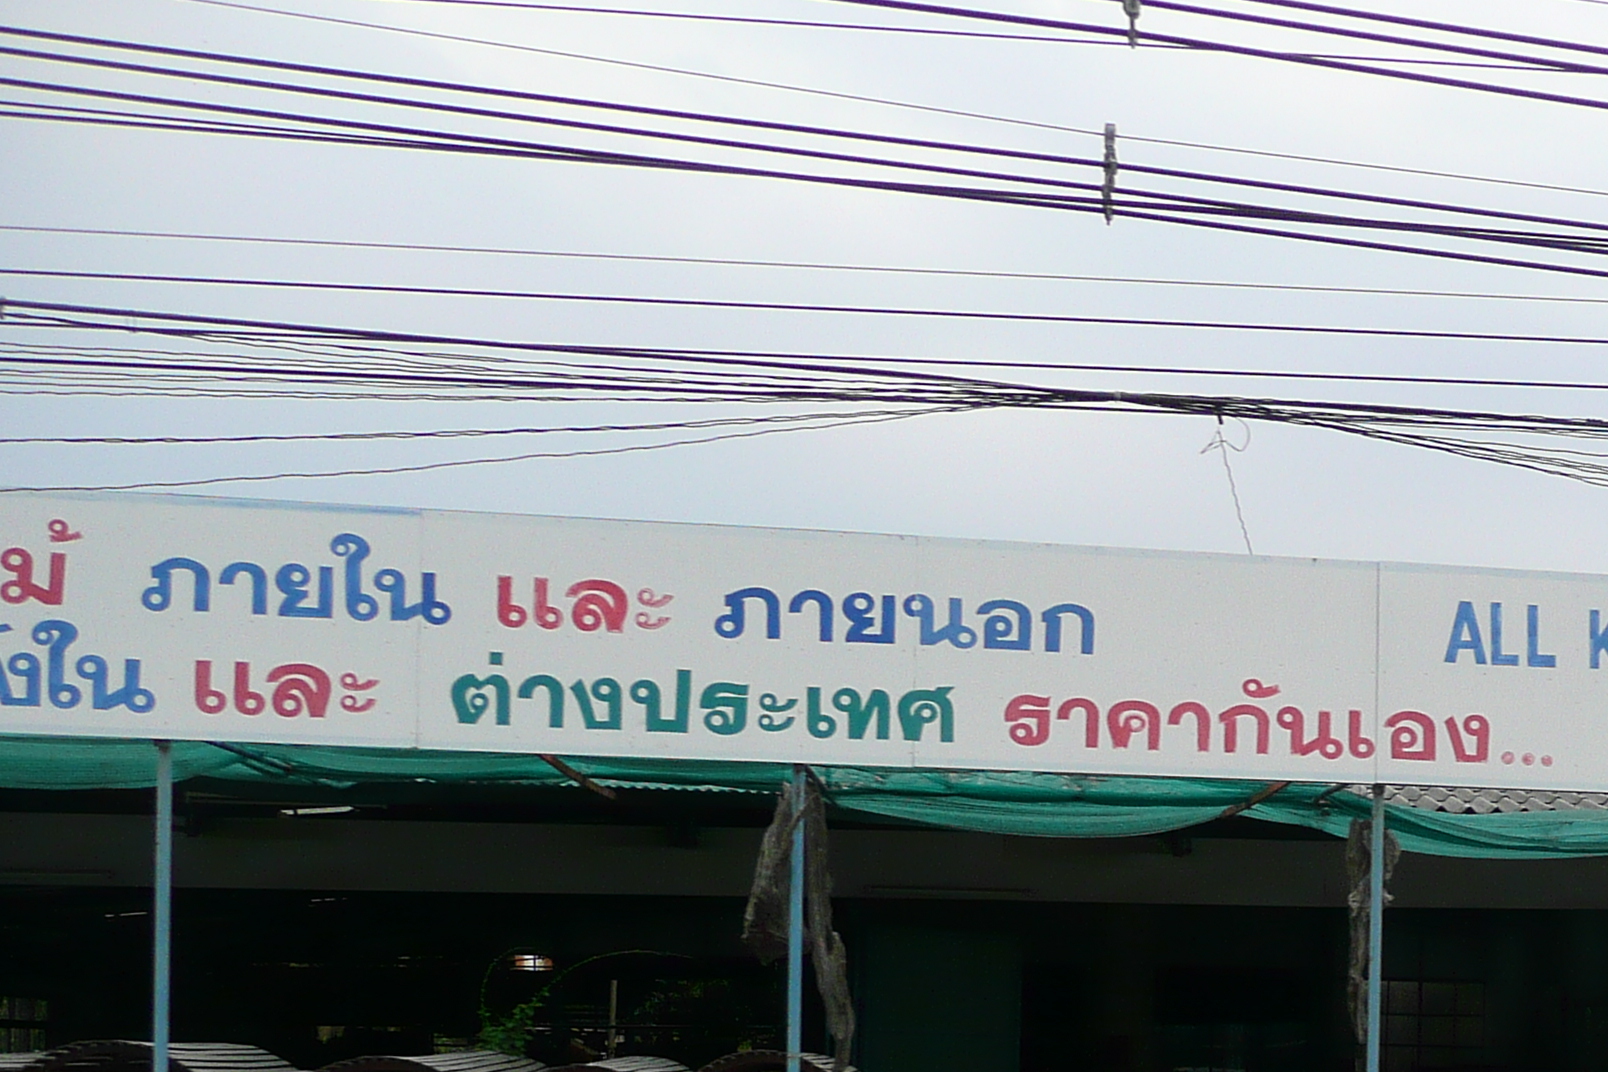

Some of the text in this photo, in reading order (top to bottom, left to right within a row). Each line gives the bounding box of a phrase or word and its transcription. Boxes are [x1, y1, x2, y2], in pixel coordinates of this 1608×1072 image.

[141, 533, 452, 626] ภายใน
[497, 575, 675, 633] และ
[714, 587, 1095, 656] ภายนอก
[1445, 601, 1556, 668] ALL
[195, 660, 380, 718] และ
[451, 651, 955, 743] ต่างประเทศ
